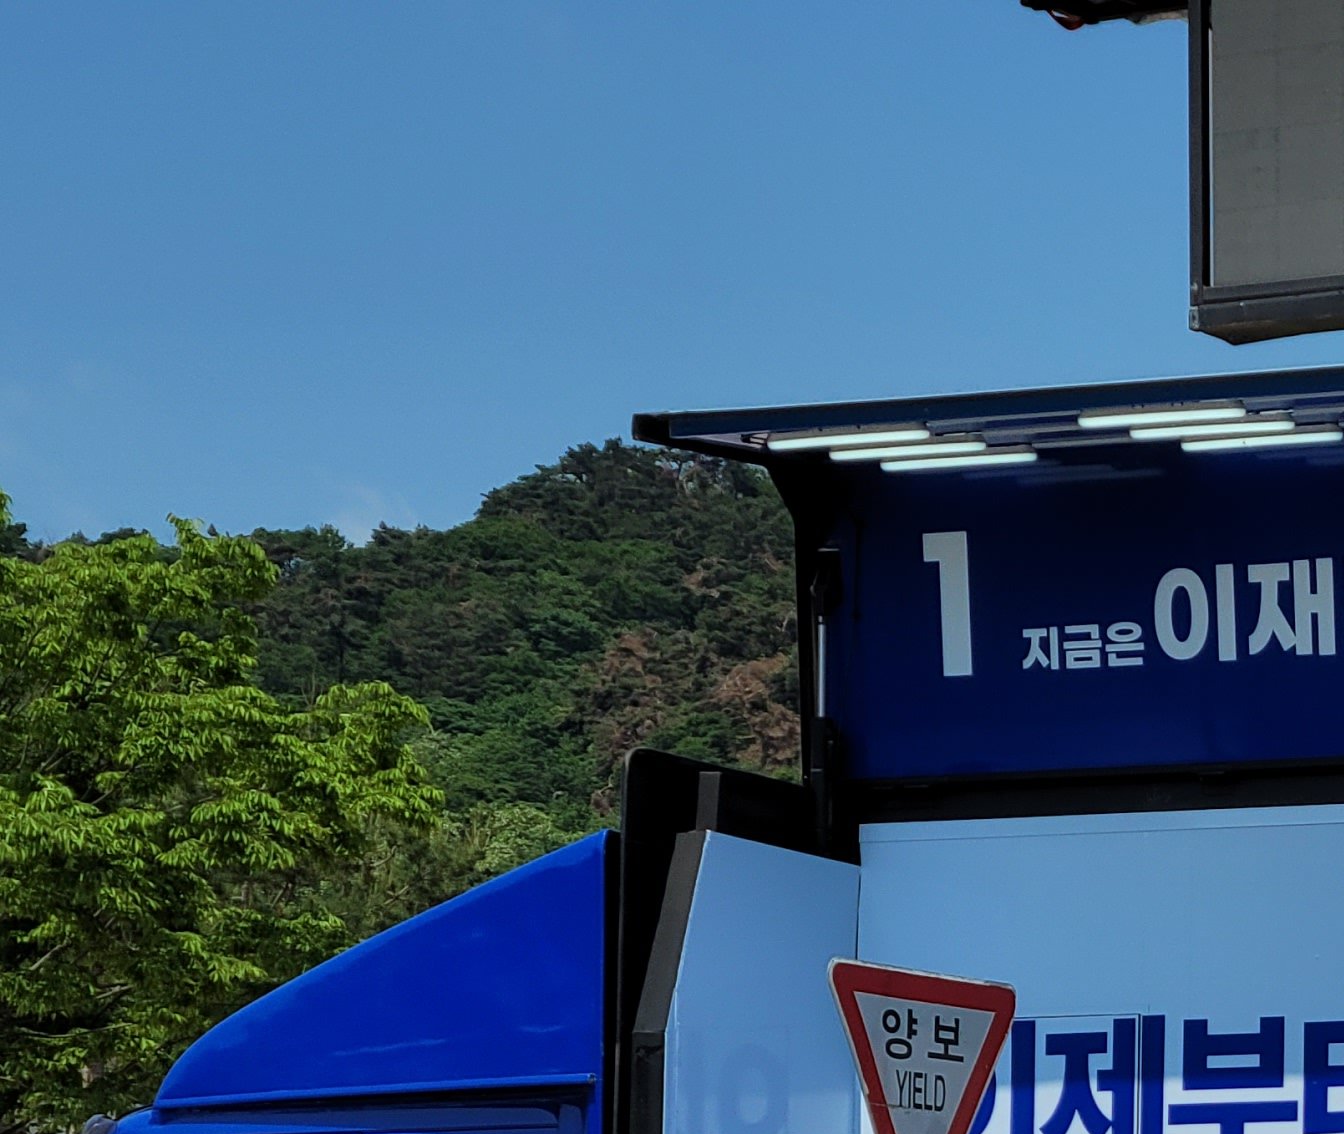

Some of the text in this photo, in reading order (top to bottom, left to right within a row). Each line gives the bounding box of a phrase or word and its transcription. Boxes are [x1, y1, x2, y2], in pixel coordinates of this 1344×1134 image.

[921, 530, 972, 677] 1
[1022, 620, 1145, 671] 지금은
[895, 1069, 947, 1113] YIELD
